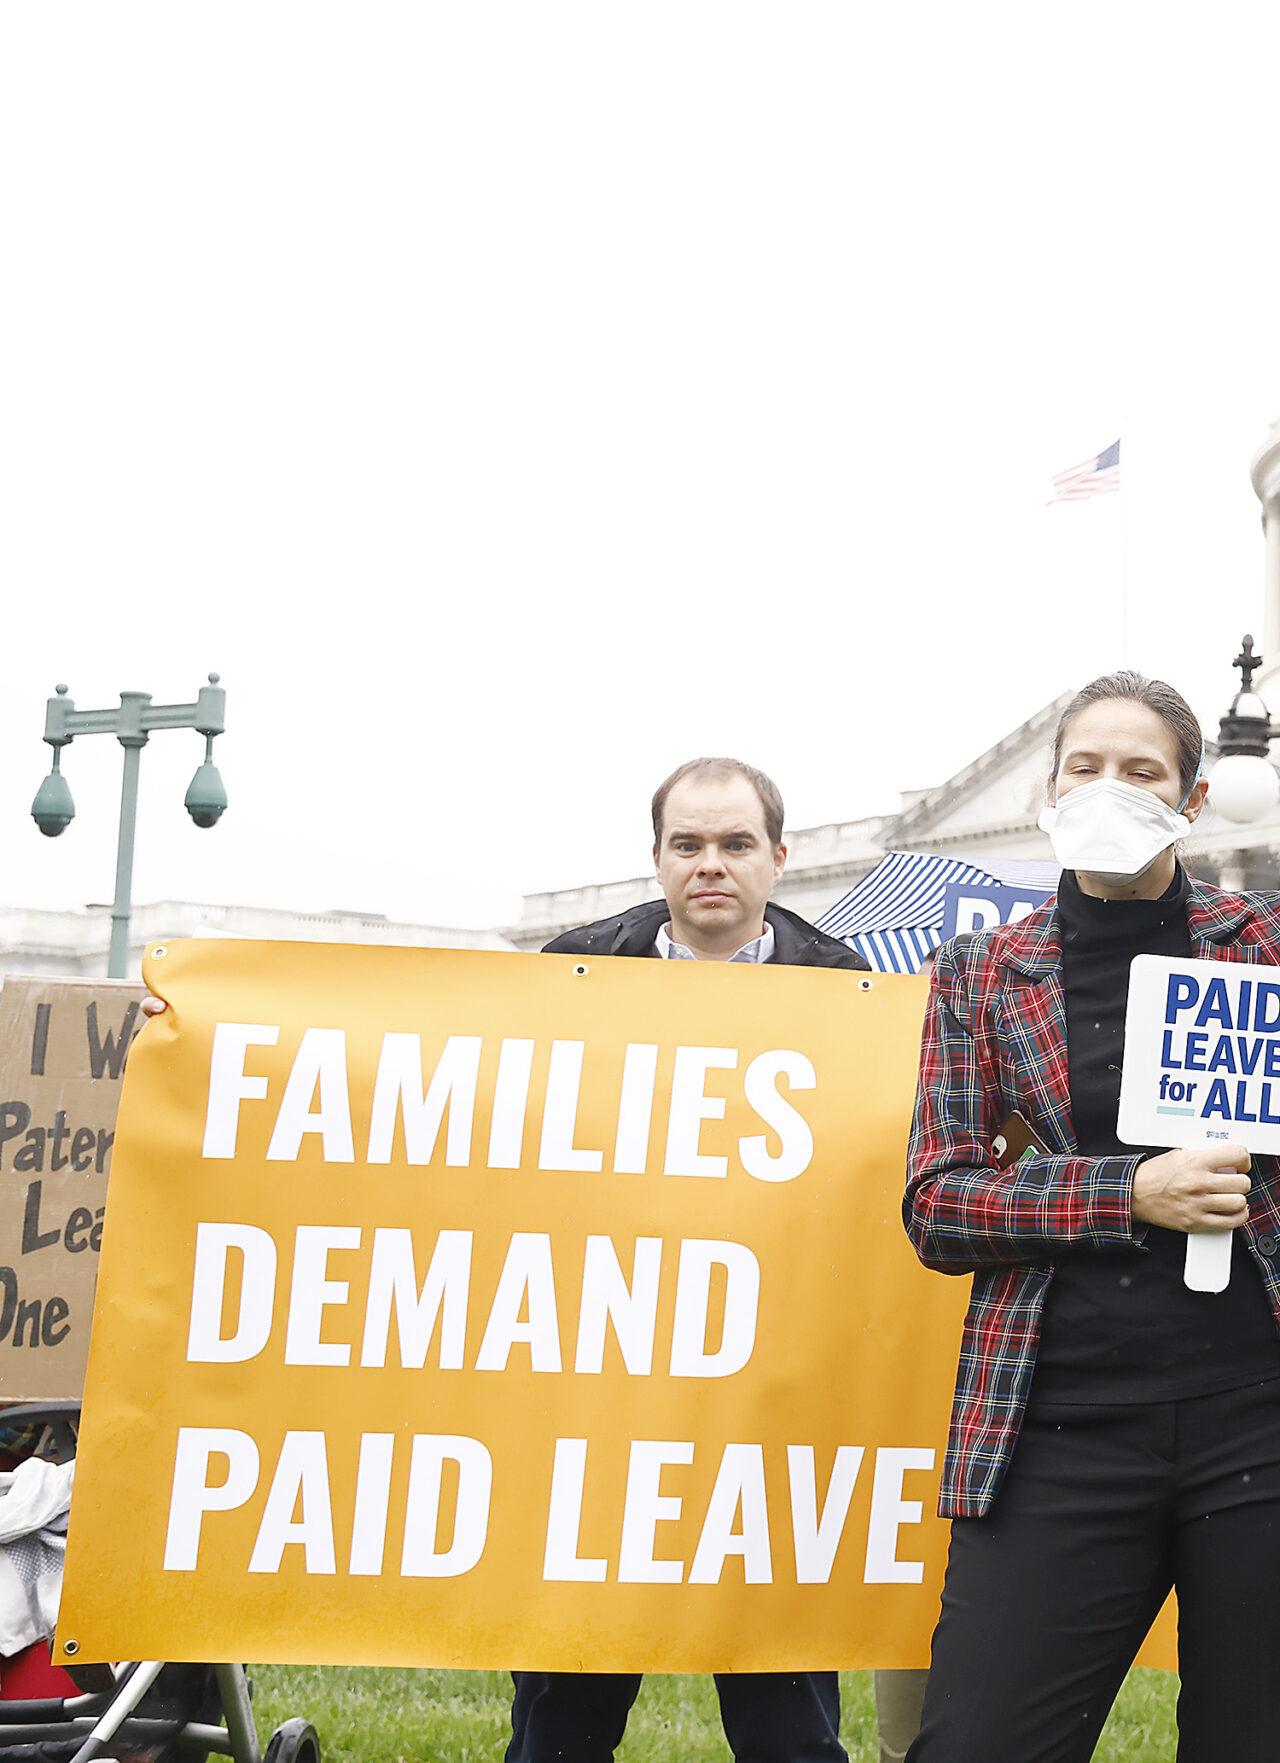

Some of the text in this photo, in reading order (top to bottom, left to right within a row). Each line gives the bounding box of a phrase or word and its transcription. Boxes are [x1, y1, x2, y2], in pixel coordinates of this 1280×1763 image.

[31, 1001, 140, 1080] I W
[203, 1022, 817, 1183] FAMILIES
[1159, 1074, 1197, 1102] for
[187, 1222, 760, 1378] DEMAND
[163, 1427, 936, 1584] PAID LEAVE
